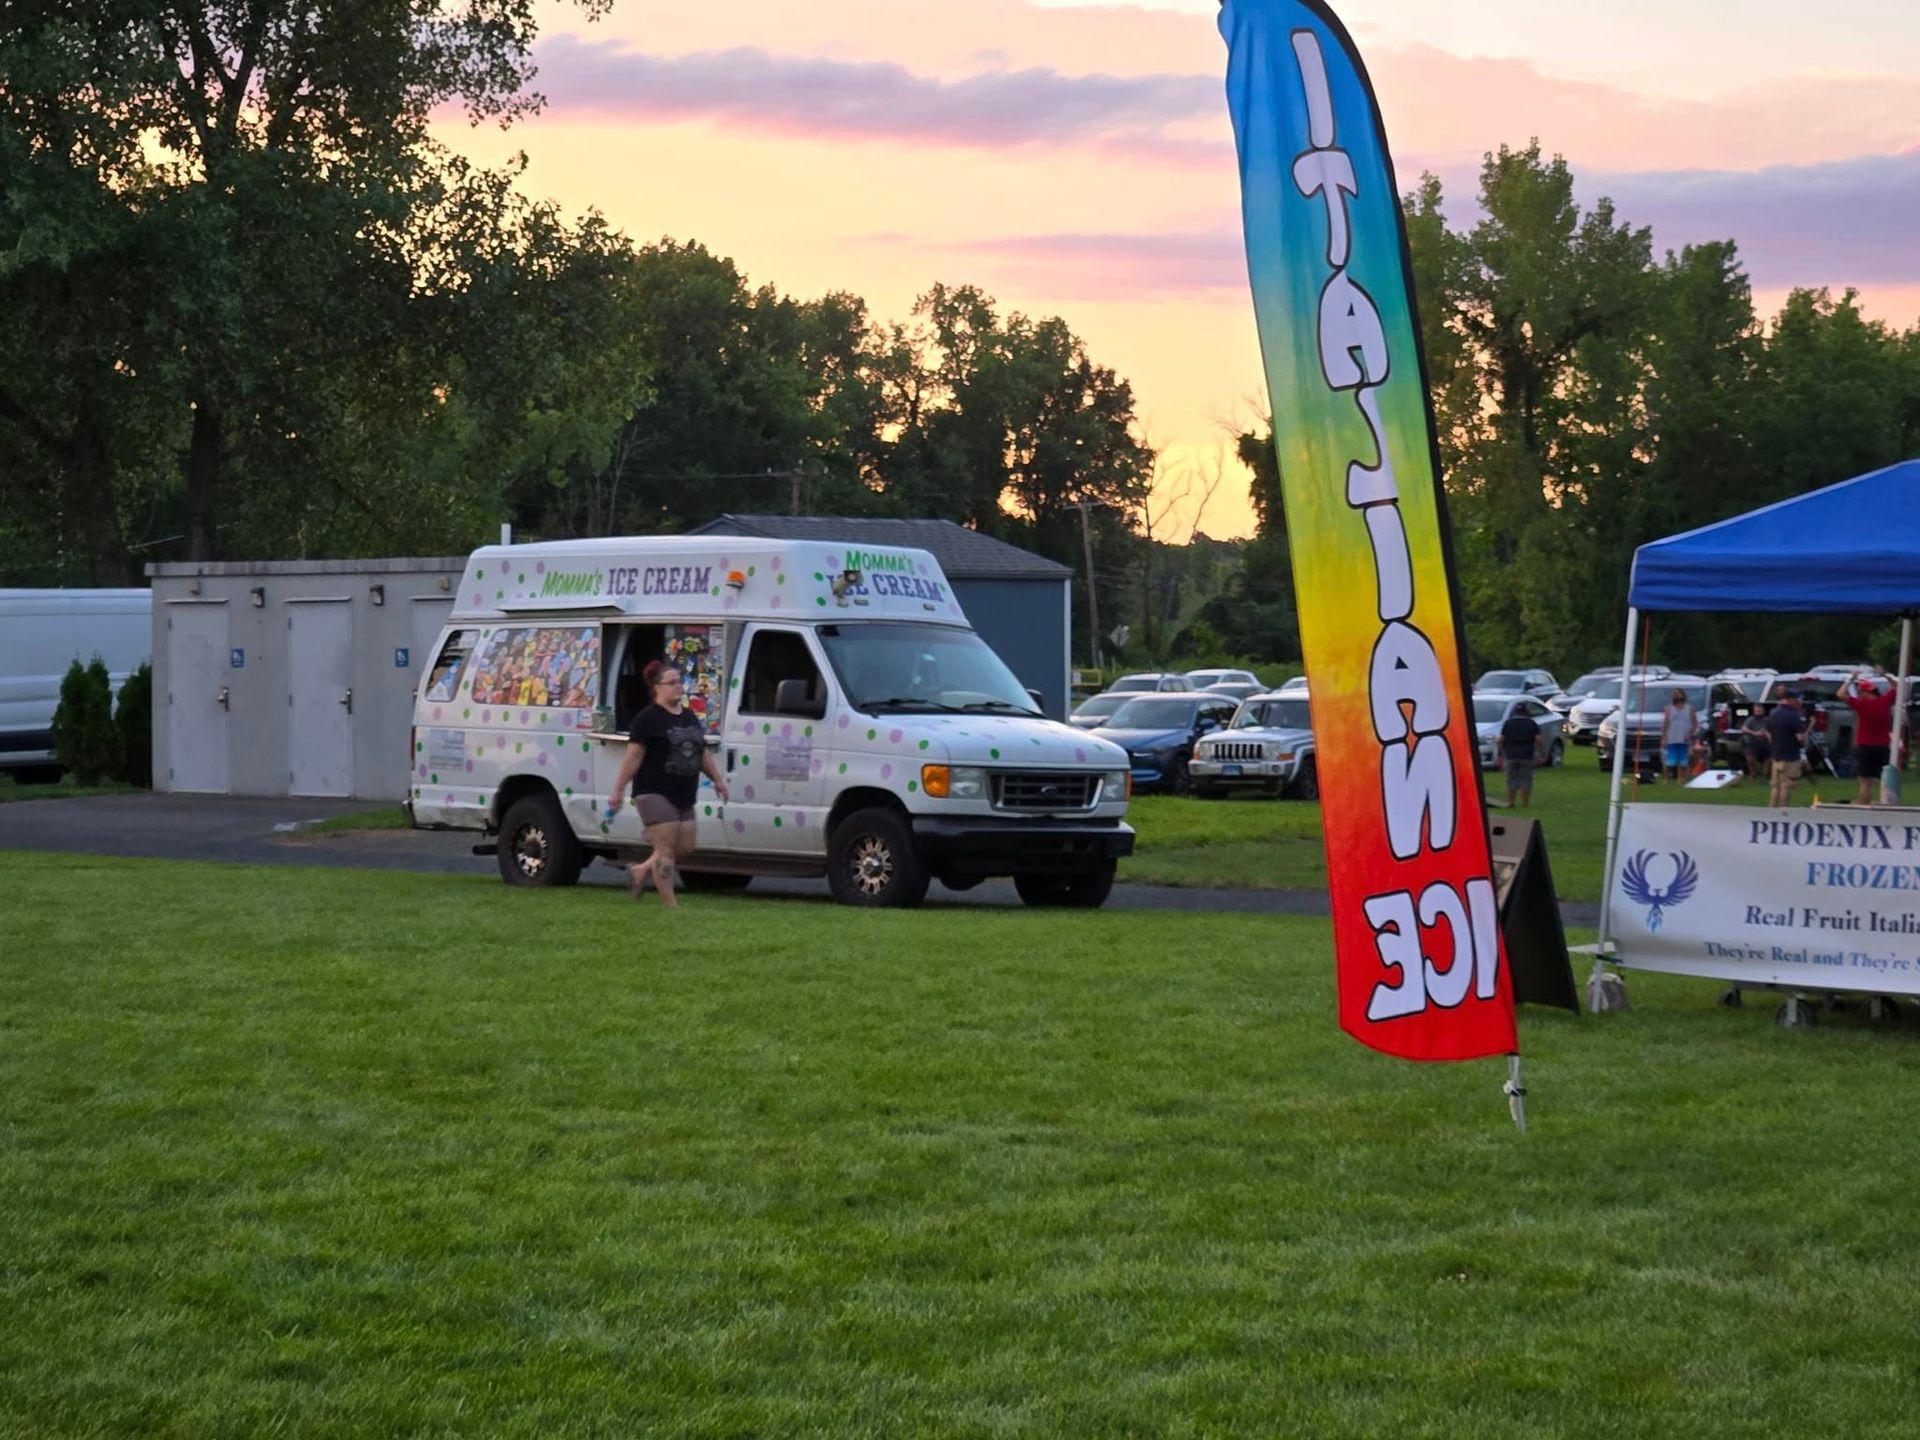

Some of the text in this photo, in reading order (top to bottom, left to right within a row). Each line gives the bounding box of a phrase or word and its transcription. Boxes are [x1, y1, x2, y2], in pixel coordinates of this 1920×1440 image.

[606, 567, 639, 596] ICE
[642, 566, 712, 595] CREAM
[871, 573, 944, 602] CREAM
[1750, 820, 1892, 849] PHOENIX
[1745, 905, 1795, 927] Real
[1803, 908, 1860, 931] Fruit
[1703, 941, 1766, 962] They're
[1771, 946, 1808, 963] Real
[1812, 951, 1844, 966] and
[1849, 952, 1910, 973] They're
